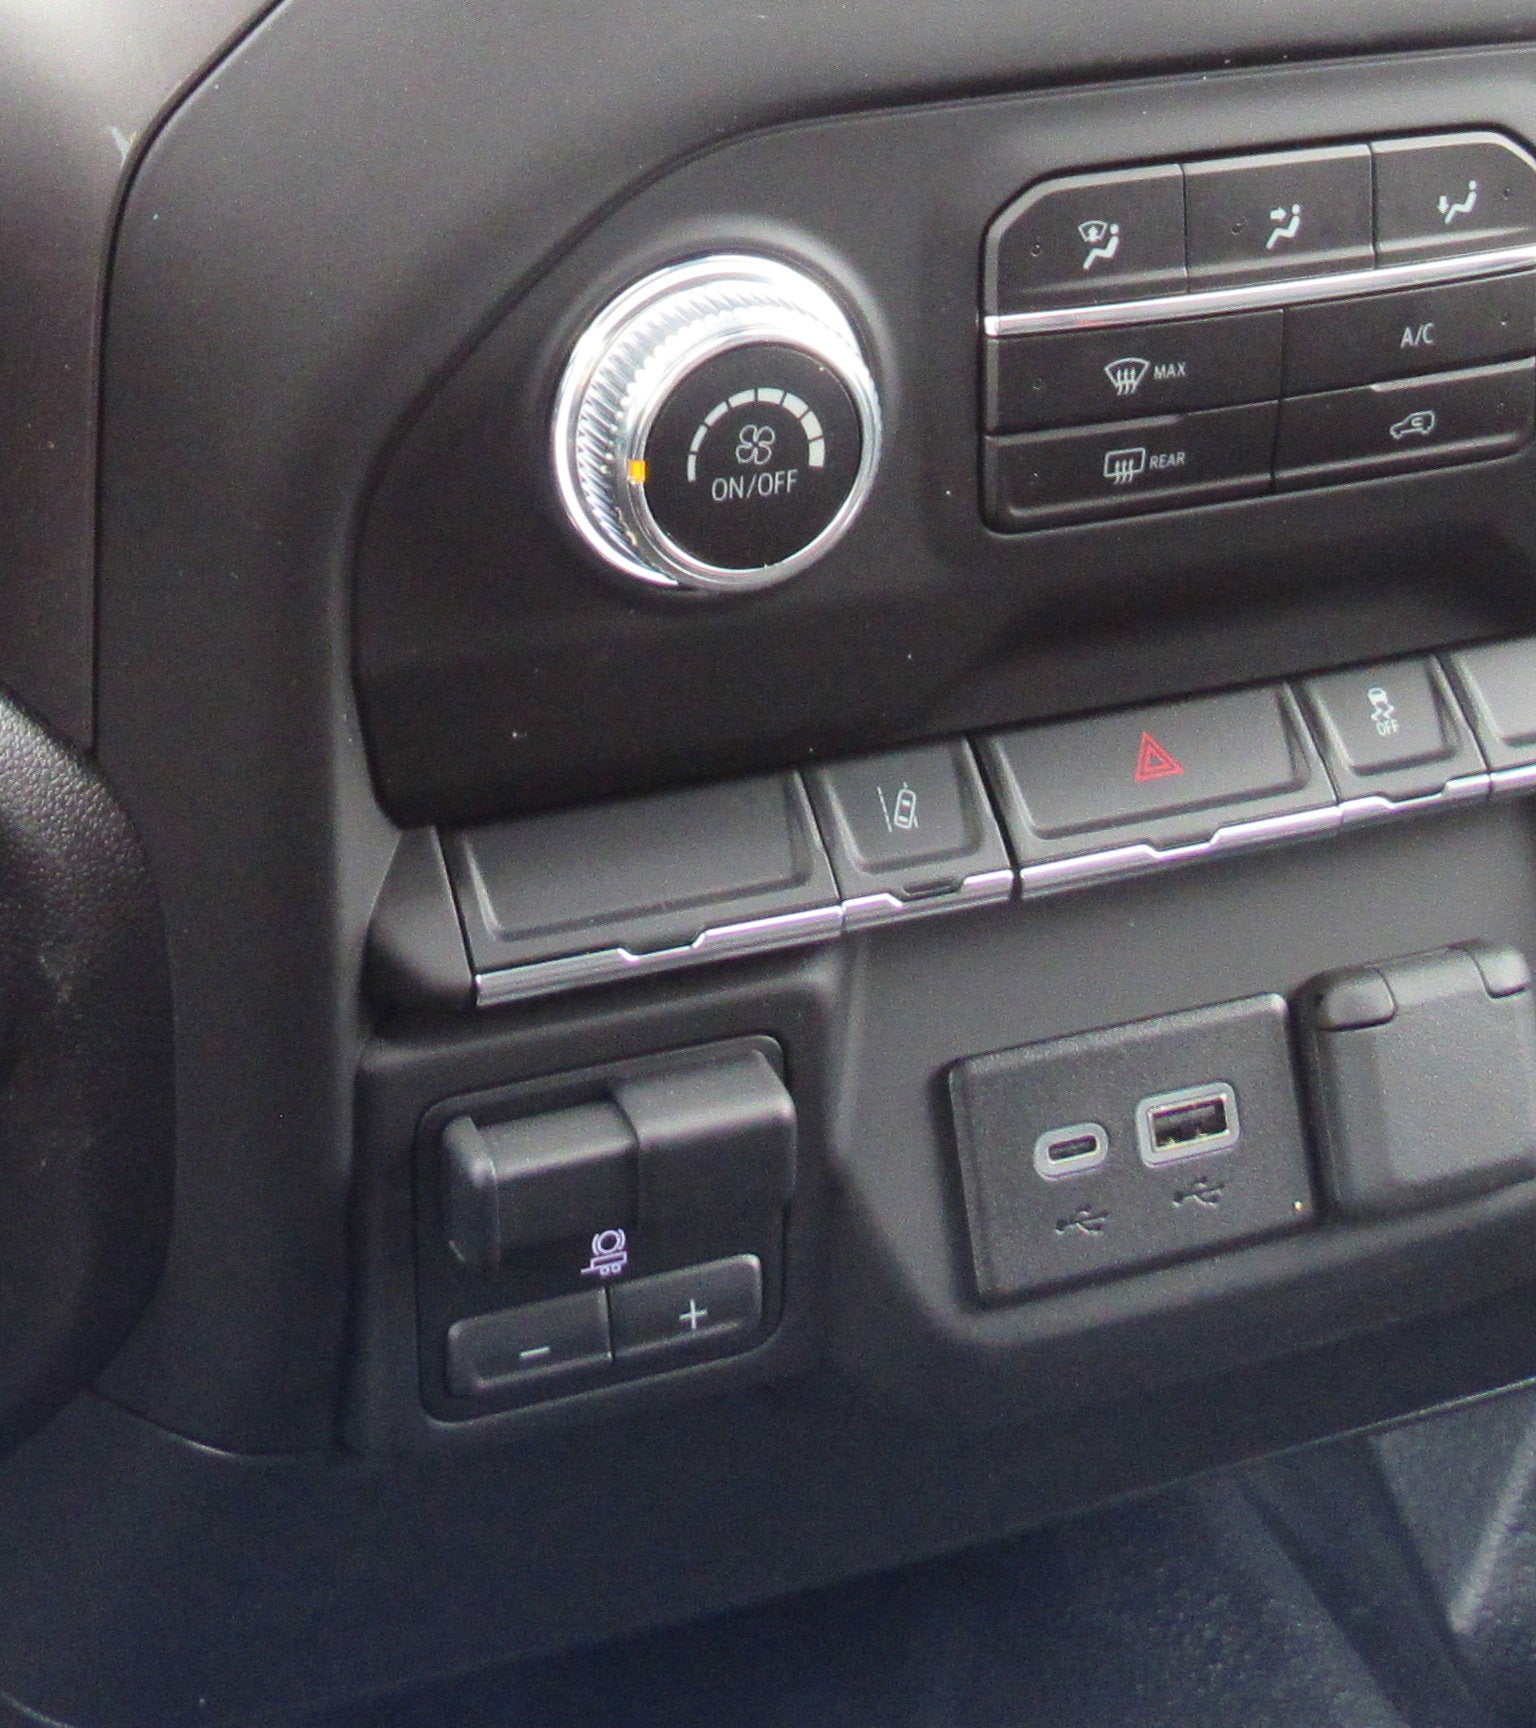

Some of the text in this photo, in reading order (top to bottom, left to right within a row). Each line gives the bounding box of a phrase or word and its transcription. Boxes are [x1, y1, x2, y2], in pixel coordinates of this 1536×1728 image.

[1400, 324, 1434, 348] A/C
[1153, 362, 1187, 380] MAX
[1149, 451, 1185, 469] REAR
[712, 469, 798, 501] ON/OFF
